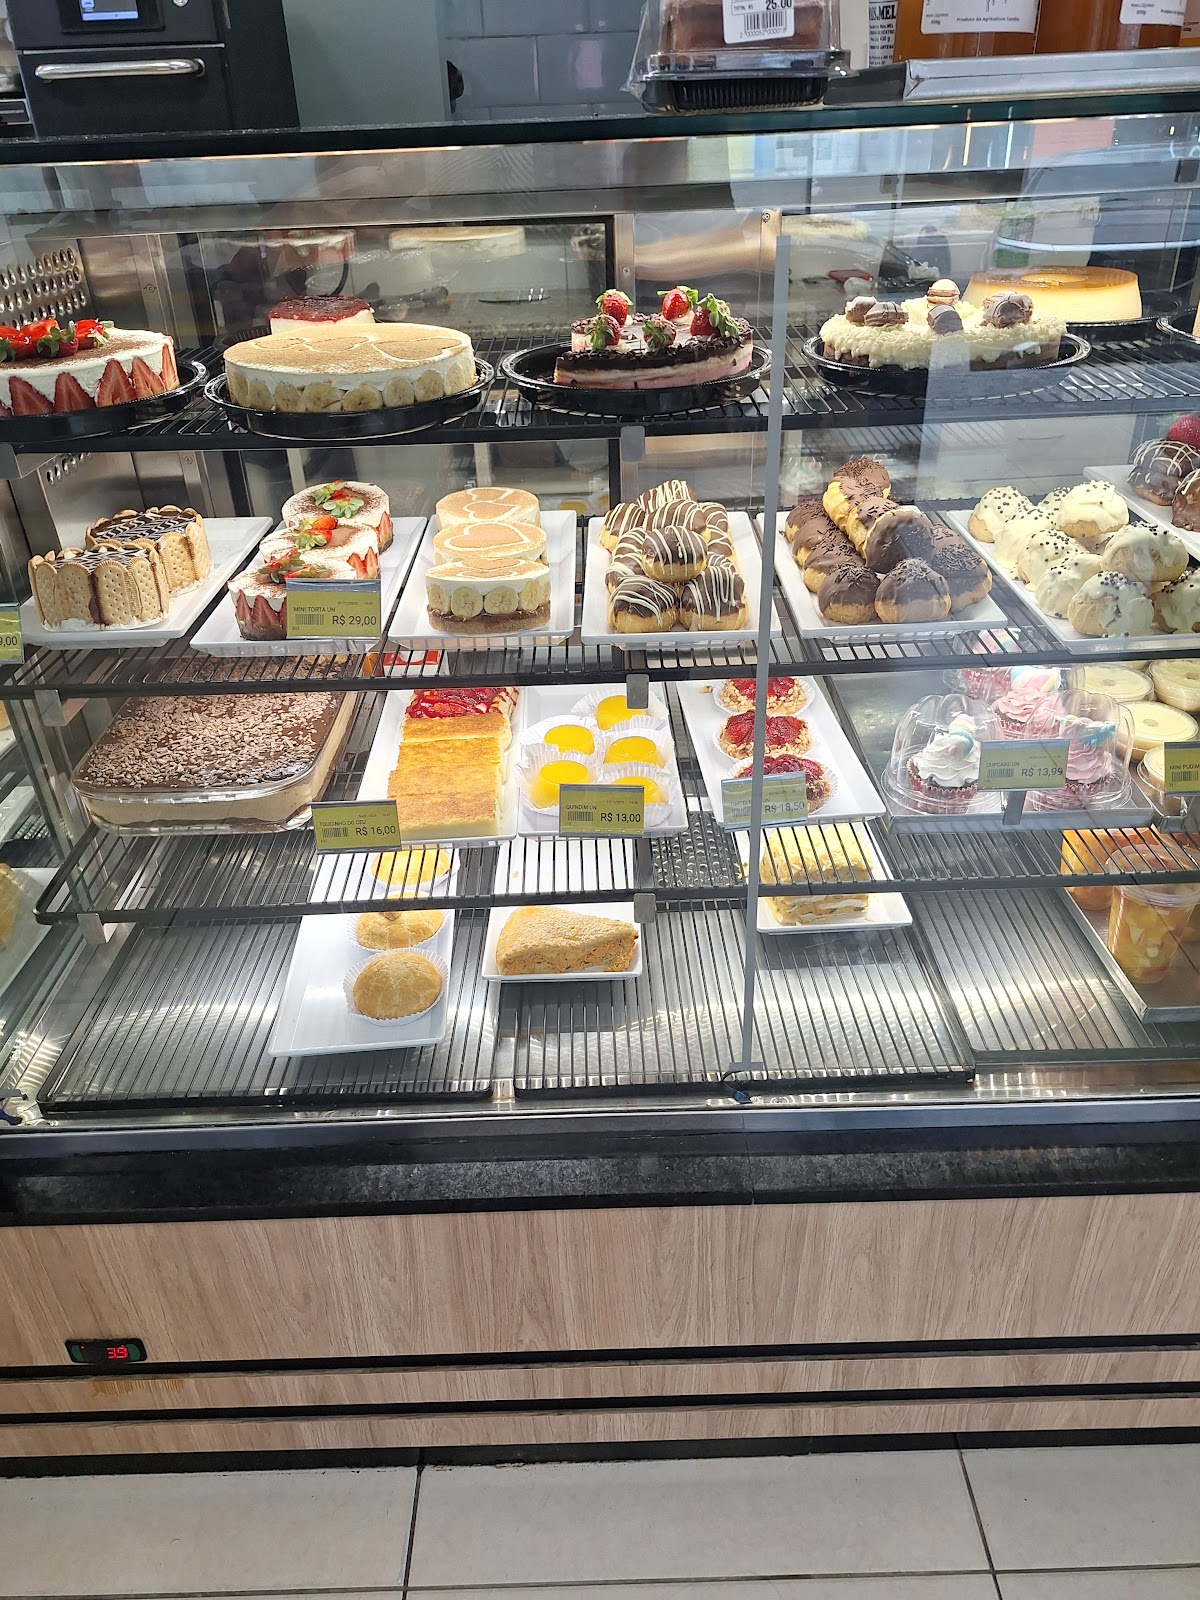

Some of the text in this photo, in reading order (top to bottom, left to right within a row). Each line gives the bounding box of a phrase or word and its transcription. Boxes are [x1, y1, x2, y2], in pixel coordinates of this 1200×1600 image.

[332, 615, 377, 627] R$ 29,00
[1021, 768, 1063, 777] R$ 13,99
[765, 801, 805, 814] R$ 18,50
[601, 812, 641, 823] R$ 13,00
[356, 825, 396, 836] R$ 16,00
